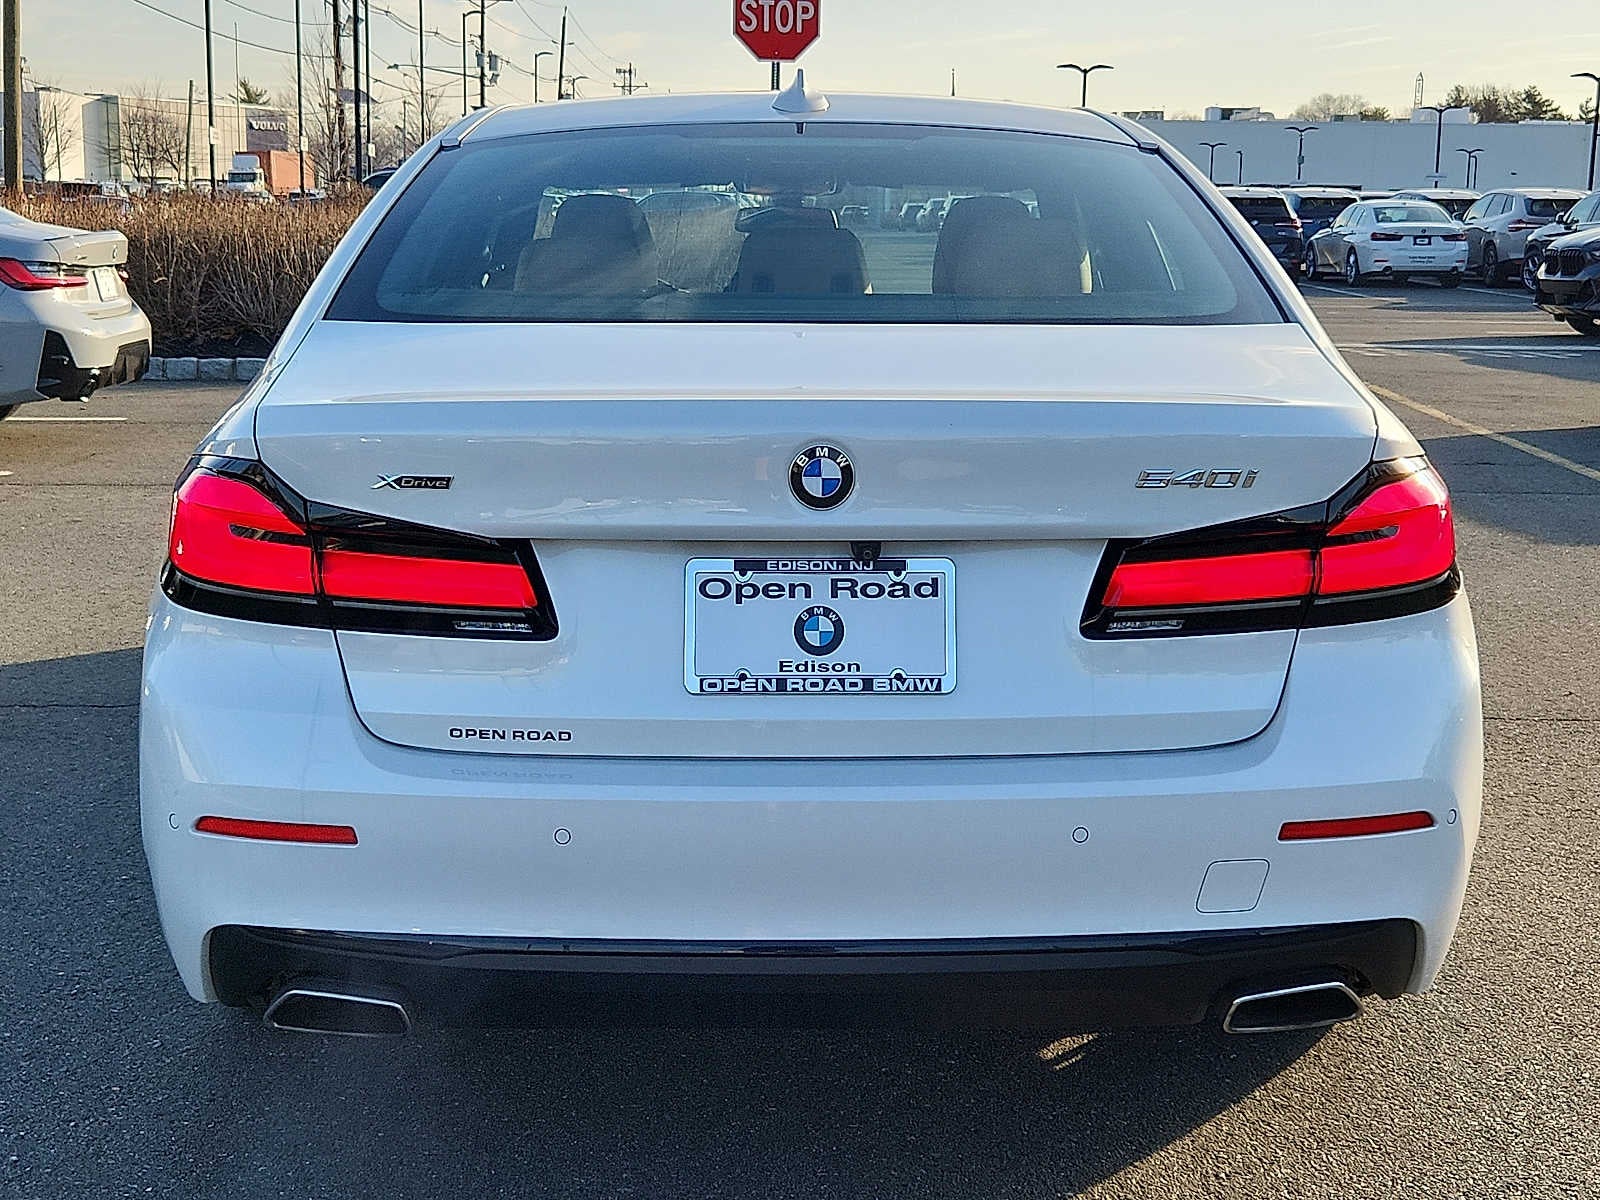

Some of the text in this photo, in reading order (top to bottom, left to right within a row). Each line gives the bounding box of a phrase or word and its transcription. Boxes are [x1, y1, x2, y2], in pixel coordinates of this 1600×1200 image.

[739, 0, 815, 33] STOP
[249, 119, 286, 131] VOLVO
[796, 447, 849, 467] BMW
[1135, 469, 1260, 488] 540i
[766, 560, 875, 572] EDISON, NJ
[698, 576, 939, 605] Open Road
[800, 606, 839, 621] BMW
[778, 660, 861, 673] Edison
[702, 678, 939, 692] OPEN ROAD BMW
[449, 727, 572, 742] OPEN ROAD
